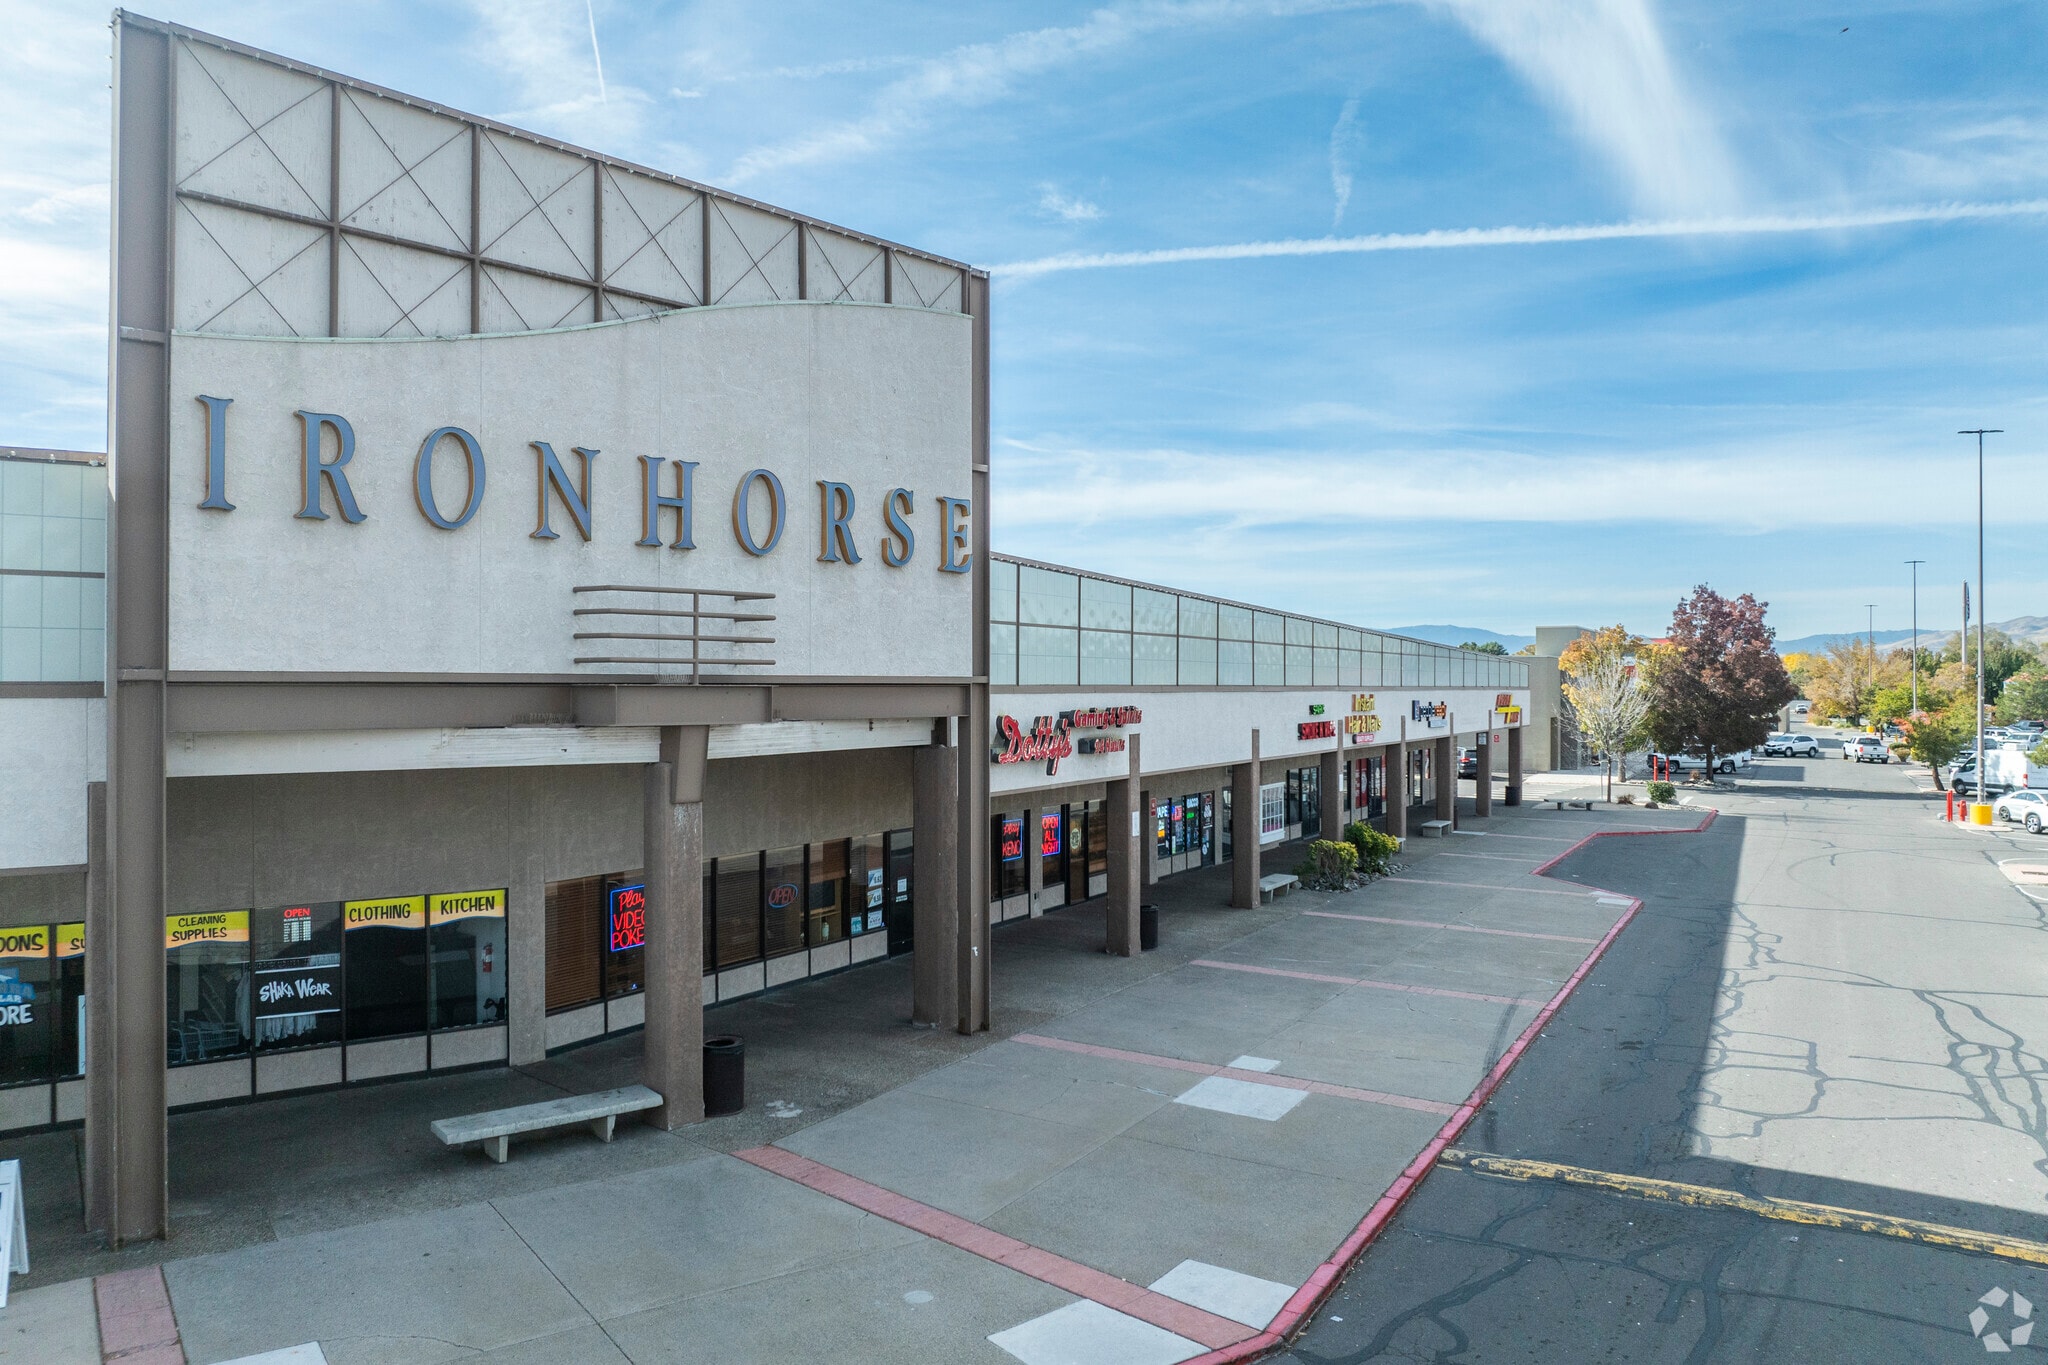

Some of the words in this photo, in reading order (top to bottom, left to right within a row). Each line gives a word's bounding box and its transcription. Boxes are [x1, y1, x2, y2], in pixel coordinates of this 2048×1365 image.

[196, 394, 975, 575] IRONHORSE
[1073, 708, 1109, 730] Gaming
[998, 714, 1073, 777] Dotty's
[1041, 815, 1059, 829] OPEN
[1044, 830, 1057, 841] ALL
[1041, 840, 1059, 855] NIGHT
[283, 907, 311, 919] OPEN
[349, 902, 411, 923] CLOTHING
[440, 895, 495, 916] KITCHEN
[178, 914, 226, 928] CLEANING
[171, 927, 227, 942] SUPPLIES
